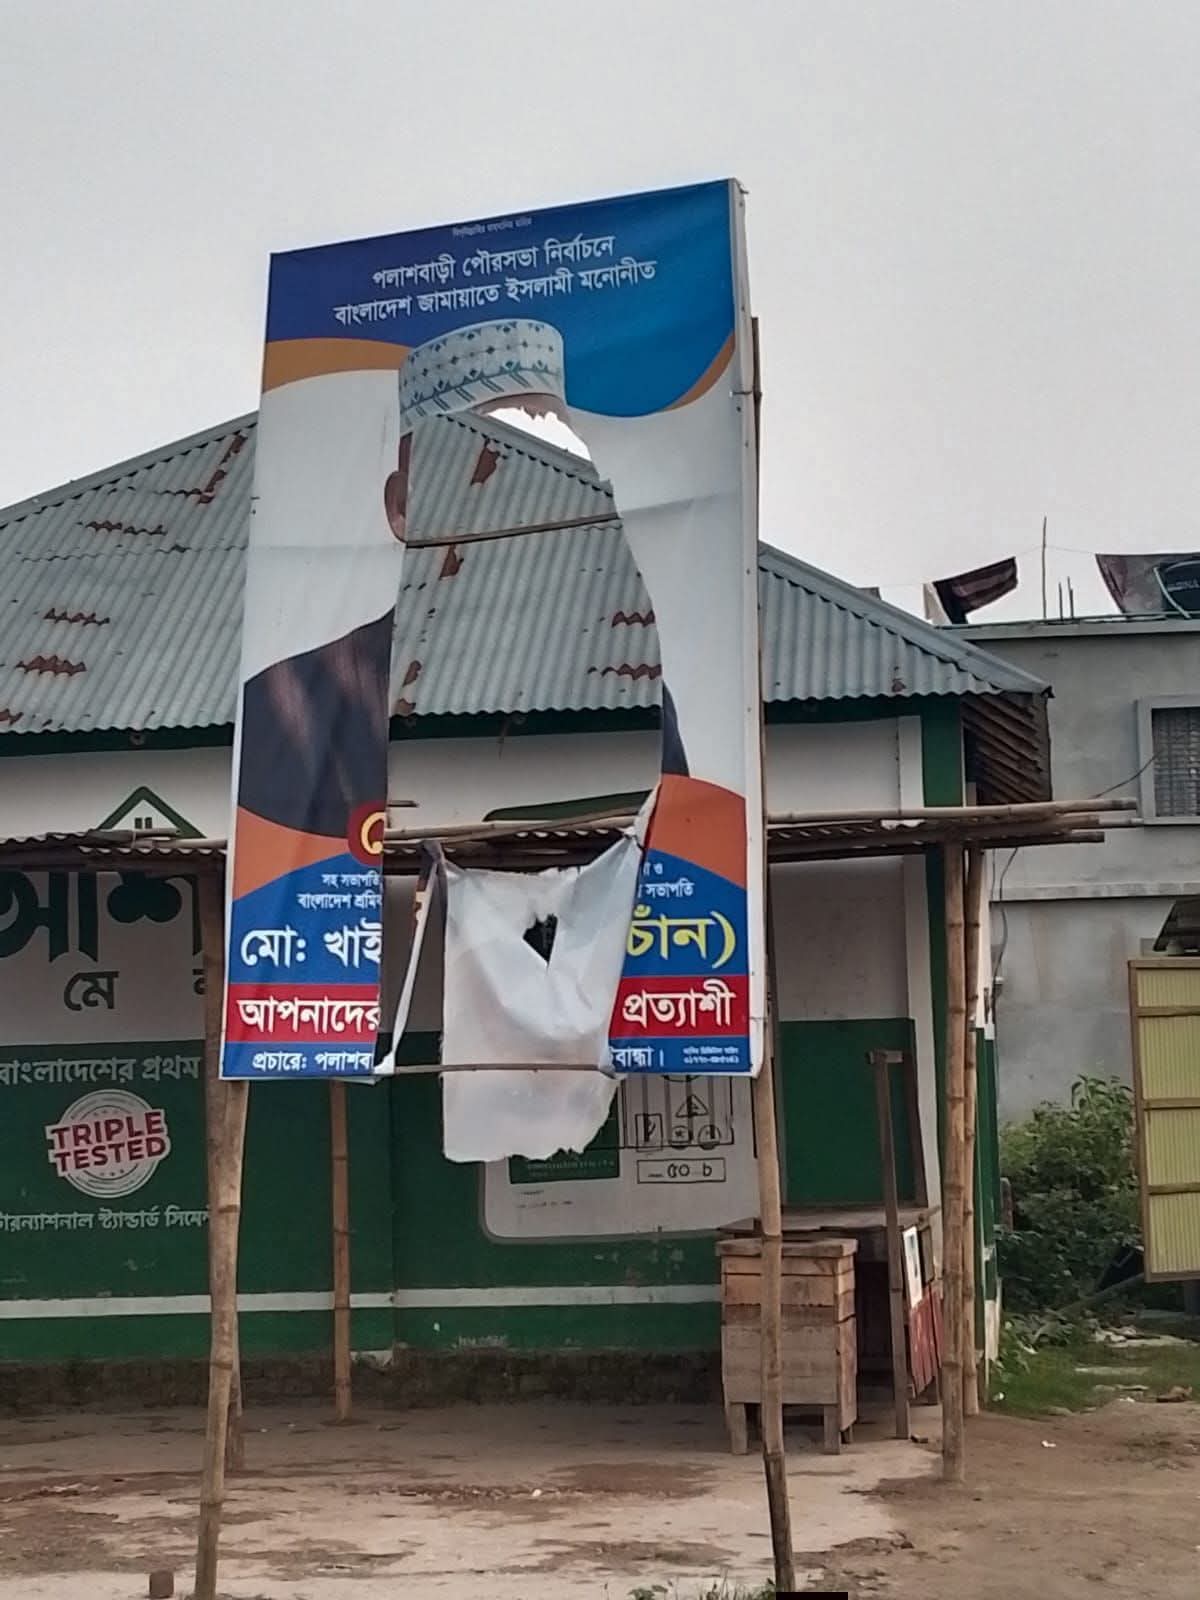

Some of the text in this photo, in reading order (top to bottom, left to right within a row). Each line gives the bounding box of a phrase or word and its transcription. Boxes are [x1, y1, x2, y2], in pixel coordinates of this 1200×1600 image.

[372, 233, 616, 288] পলাশবাড়ী পৌরসভা নির্বাচনে
[333, 256, 657, 326] বাংলাদেশ জামায়াতে ইসলামী মনোনীত
[297, 892, 352, 911] বাংলাদেশ
[645, 877, 695, 899] সভাপতি
[623, 978, 737, 1028] প্রত্যাশী
[0, 1055, 202, 1085] বাংলাদেশের প্রথম
[51, 1111, 164, 1149] TRIPLE
[54, 1136, 166, 1172] TESTED
